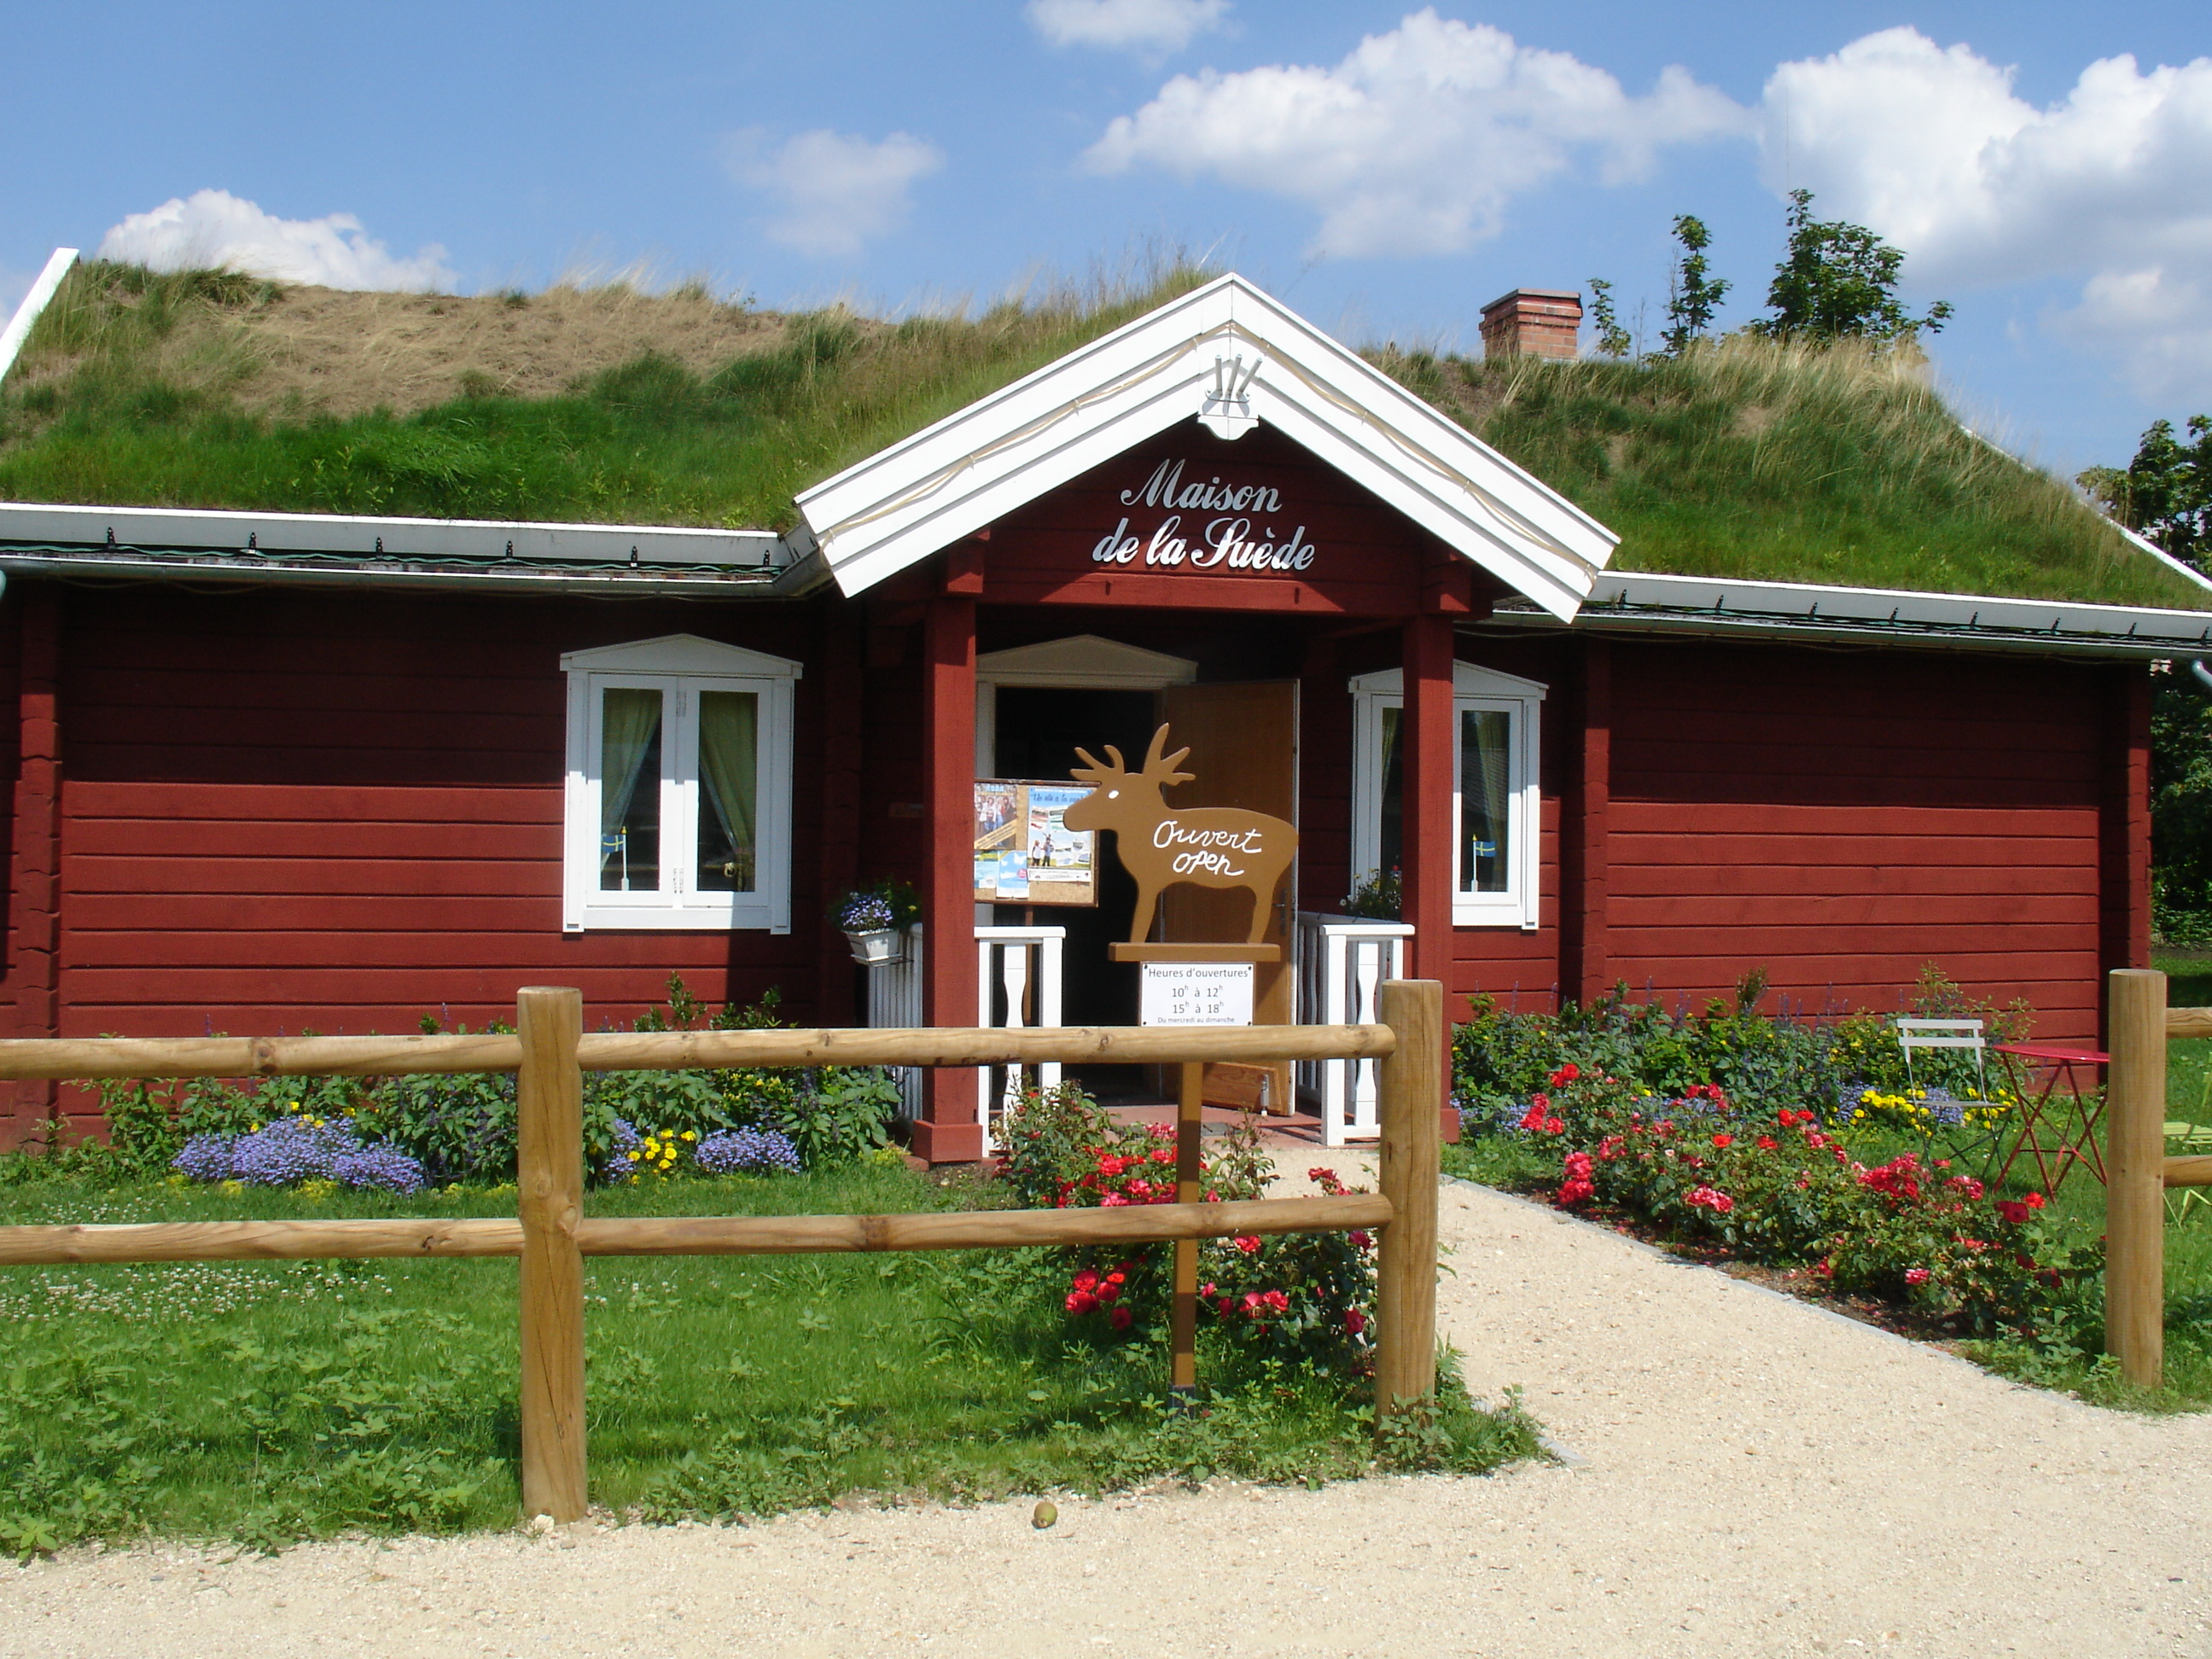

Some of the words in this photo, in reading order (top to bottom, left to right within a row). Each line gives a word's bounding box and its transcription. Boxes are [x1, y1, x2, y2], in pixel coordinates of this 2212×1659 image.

[1121, 458, 1283, 512] Maison
[1092, 517, 1139, 564] de
[1145, 515, 1188, 565] la
[1190, 517, 1315, 570] Suède
[1153, 820, 1262, 853] Ouvert
[1173, 850, 1244, 876] open
[1149, 969, 1184, 977] Heures
[1186, 968, 1249, 977] d'ouvertures
[1194, 987, 1201, 998] à
[1195, 1004, 1201, 1014] à
